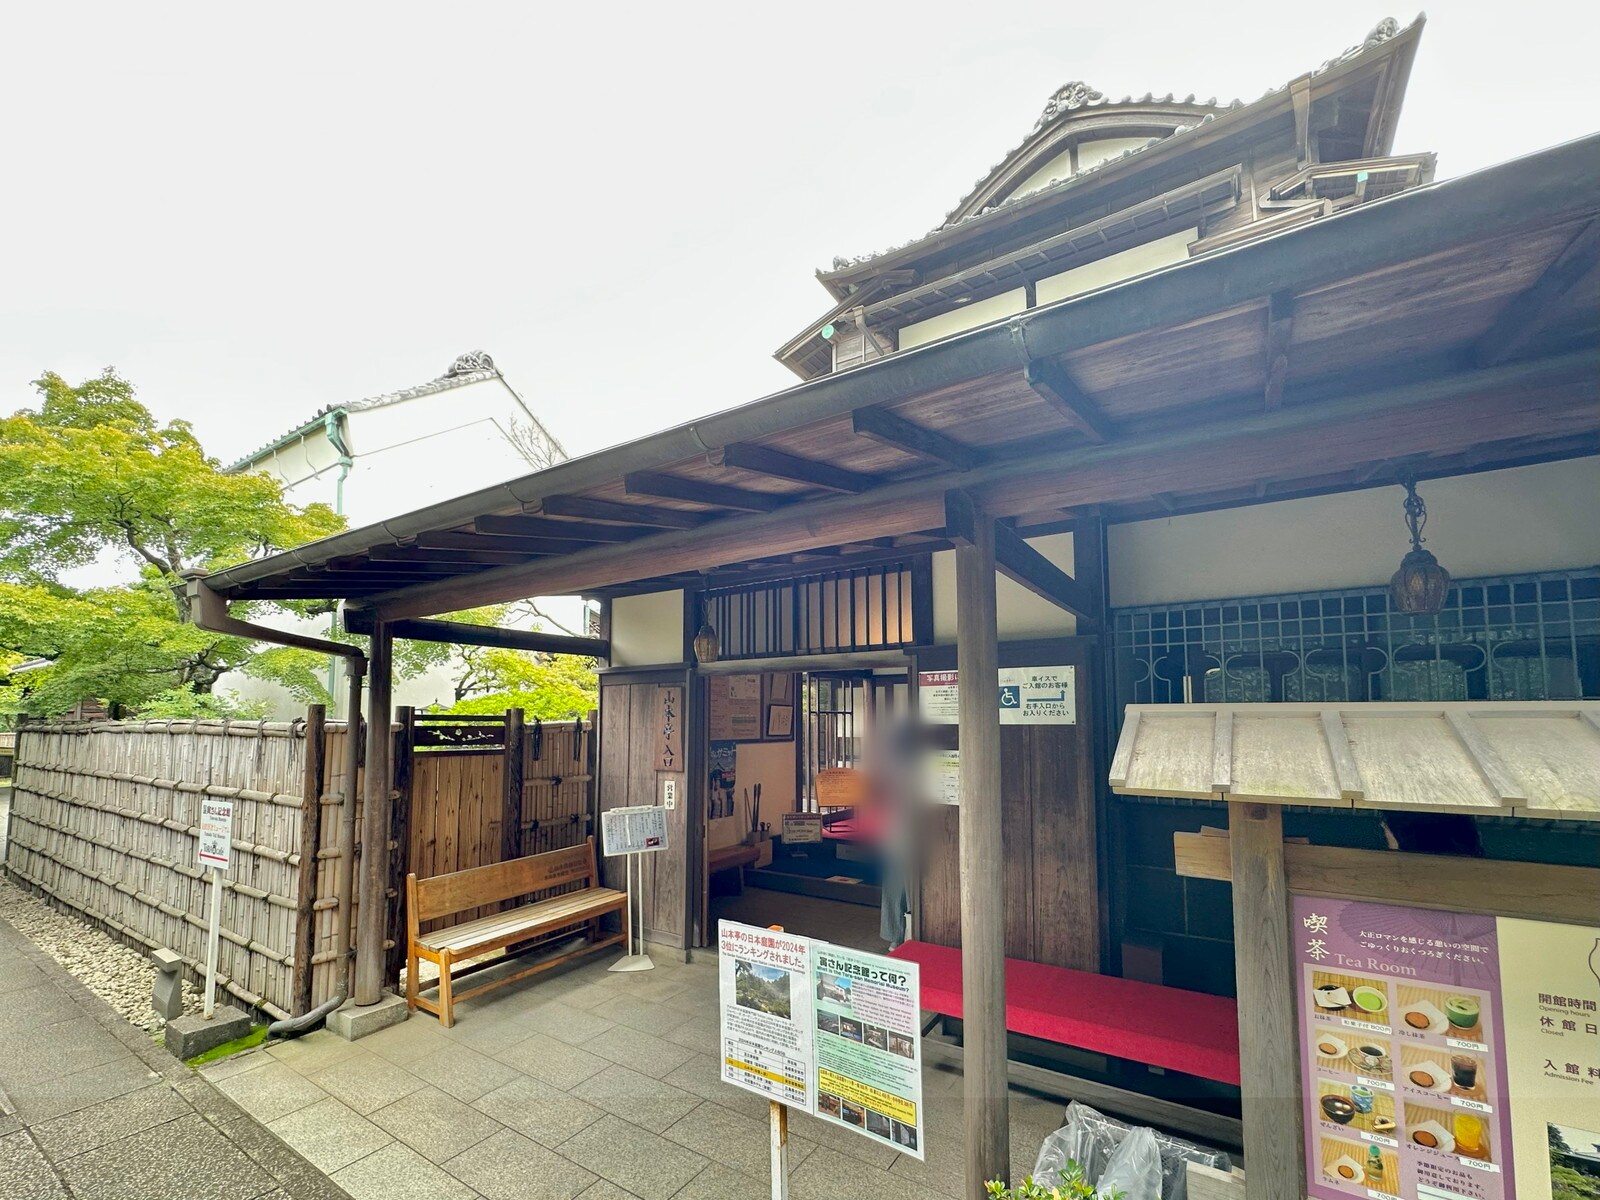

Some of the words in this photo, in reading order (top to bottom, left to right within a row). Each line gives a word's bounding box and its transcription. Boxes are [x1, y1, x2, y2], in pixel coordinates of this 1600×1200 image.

[666, 784, 674, 809] 営業中
[721, 928, 806, 955] 山本亭の日本庭園が2024年
[1303, 913, 1330, 961] 喫茶
[721, 940, 805, 969] 3位にランキングされました。
[1359, 941, 1485, 965] ごゆっくりおくつろぎください。
[1334, 953, 1362, 968] Tea
[1367, 959, 1417, 976] Room
[1538, 993, 1597, 1012] 開館時間
[1539, 1005, 1569, 1016] Opening
[1570, 1009, 1591, 1018] hours
[1540, 1015, 1598, 1035] 休館日
[1541, 1029, 1564, 1037] Closed
[1456, 1041, 1479, 1050] 700円
[1544, 1059, 1600, 1080] 入館料
[1366, 1079, 1387, 1088] 700円
[1544, 1071, 1580, 1083] Admission
[1581, 1078, 1594, 1086] Fee
[1403, 1086, 1450, 1101] アイスコーヒー
[1460, 1101, 1484, 1110] 700円
[1370, 1134, 1391, 1145] 700円
[1467, 1159, 1491, 1169] 700円
